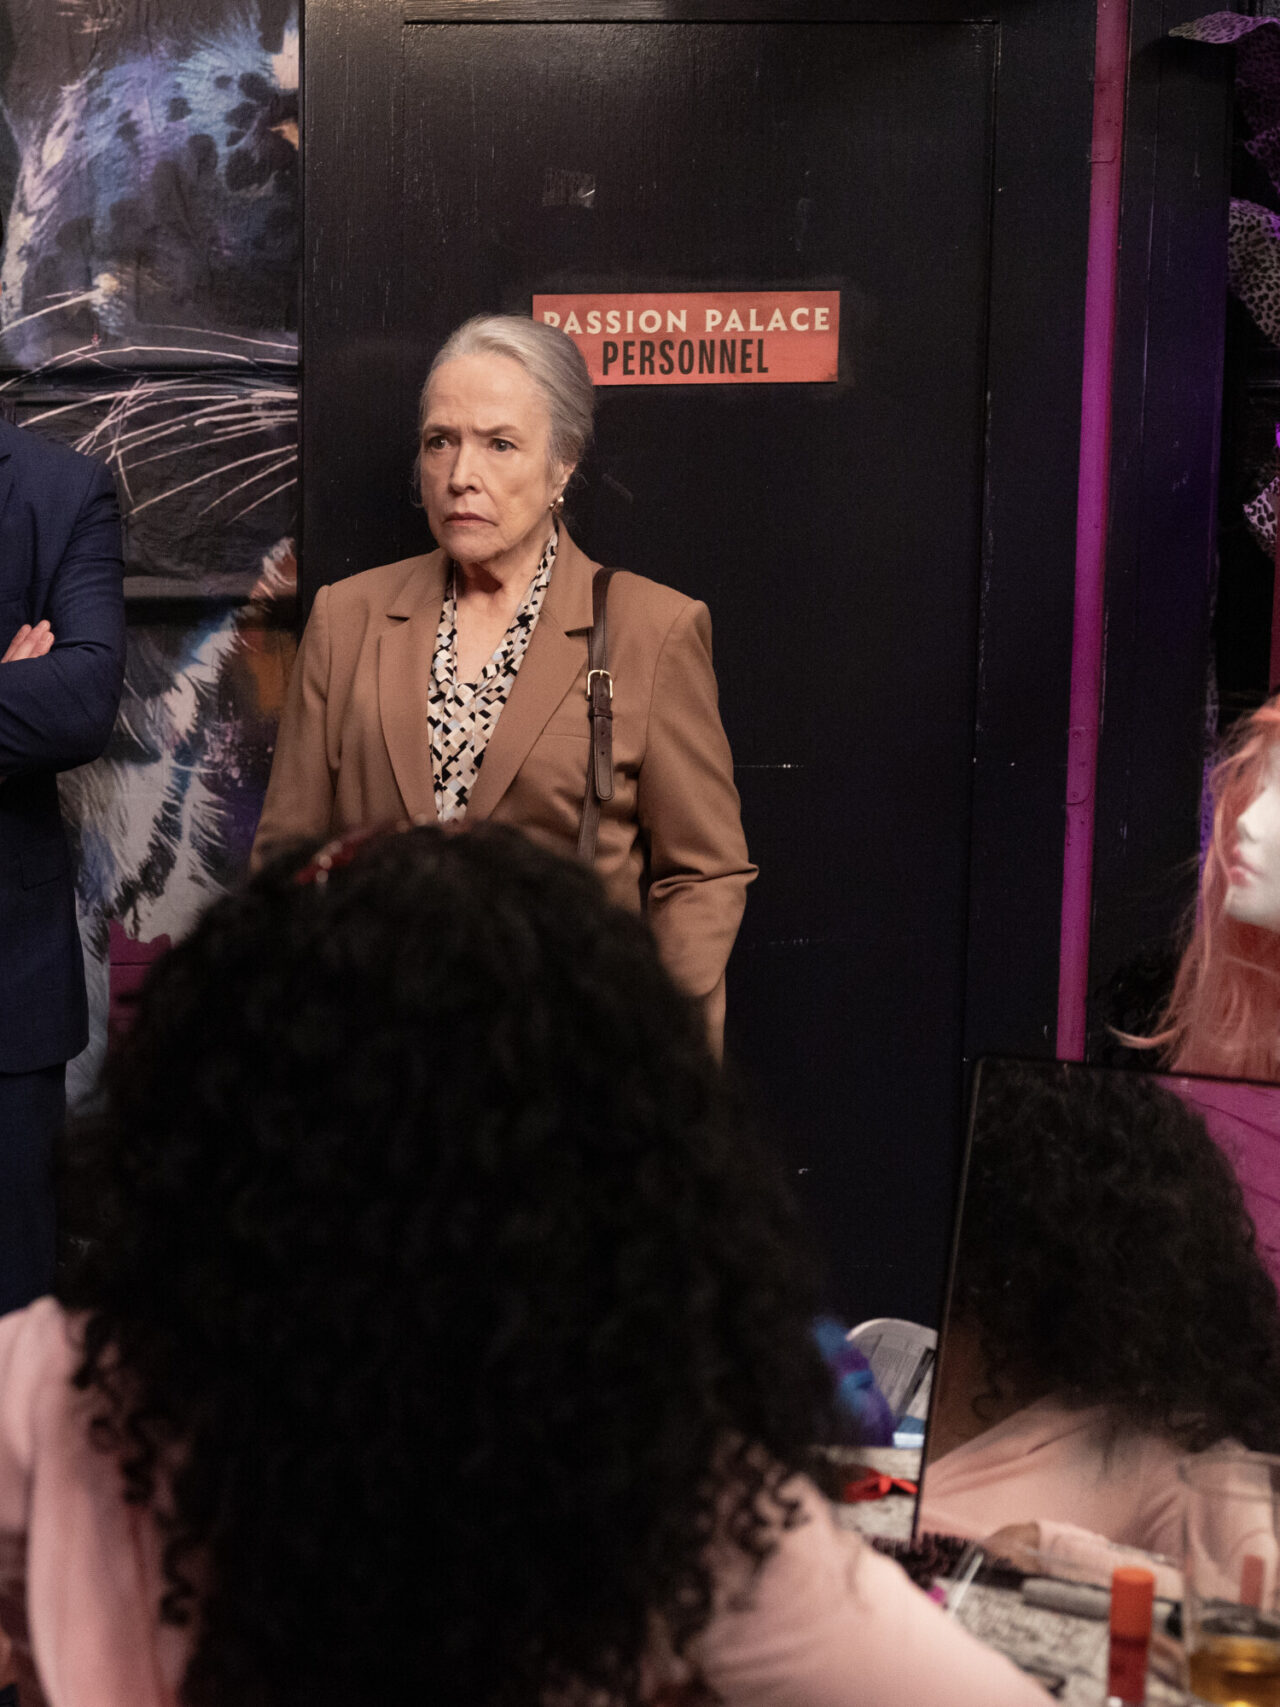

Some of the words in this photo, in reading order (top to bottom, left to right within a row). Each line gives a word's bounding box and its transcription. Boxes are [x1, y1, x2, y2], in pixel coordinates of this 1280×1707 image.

[543, 309, 687, 334] PASSION
[705, 308, 830, 332] PALACE
[602, 339, 769, 376] PERSONNEL
